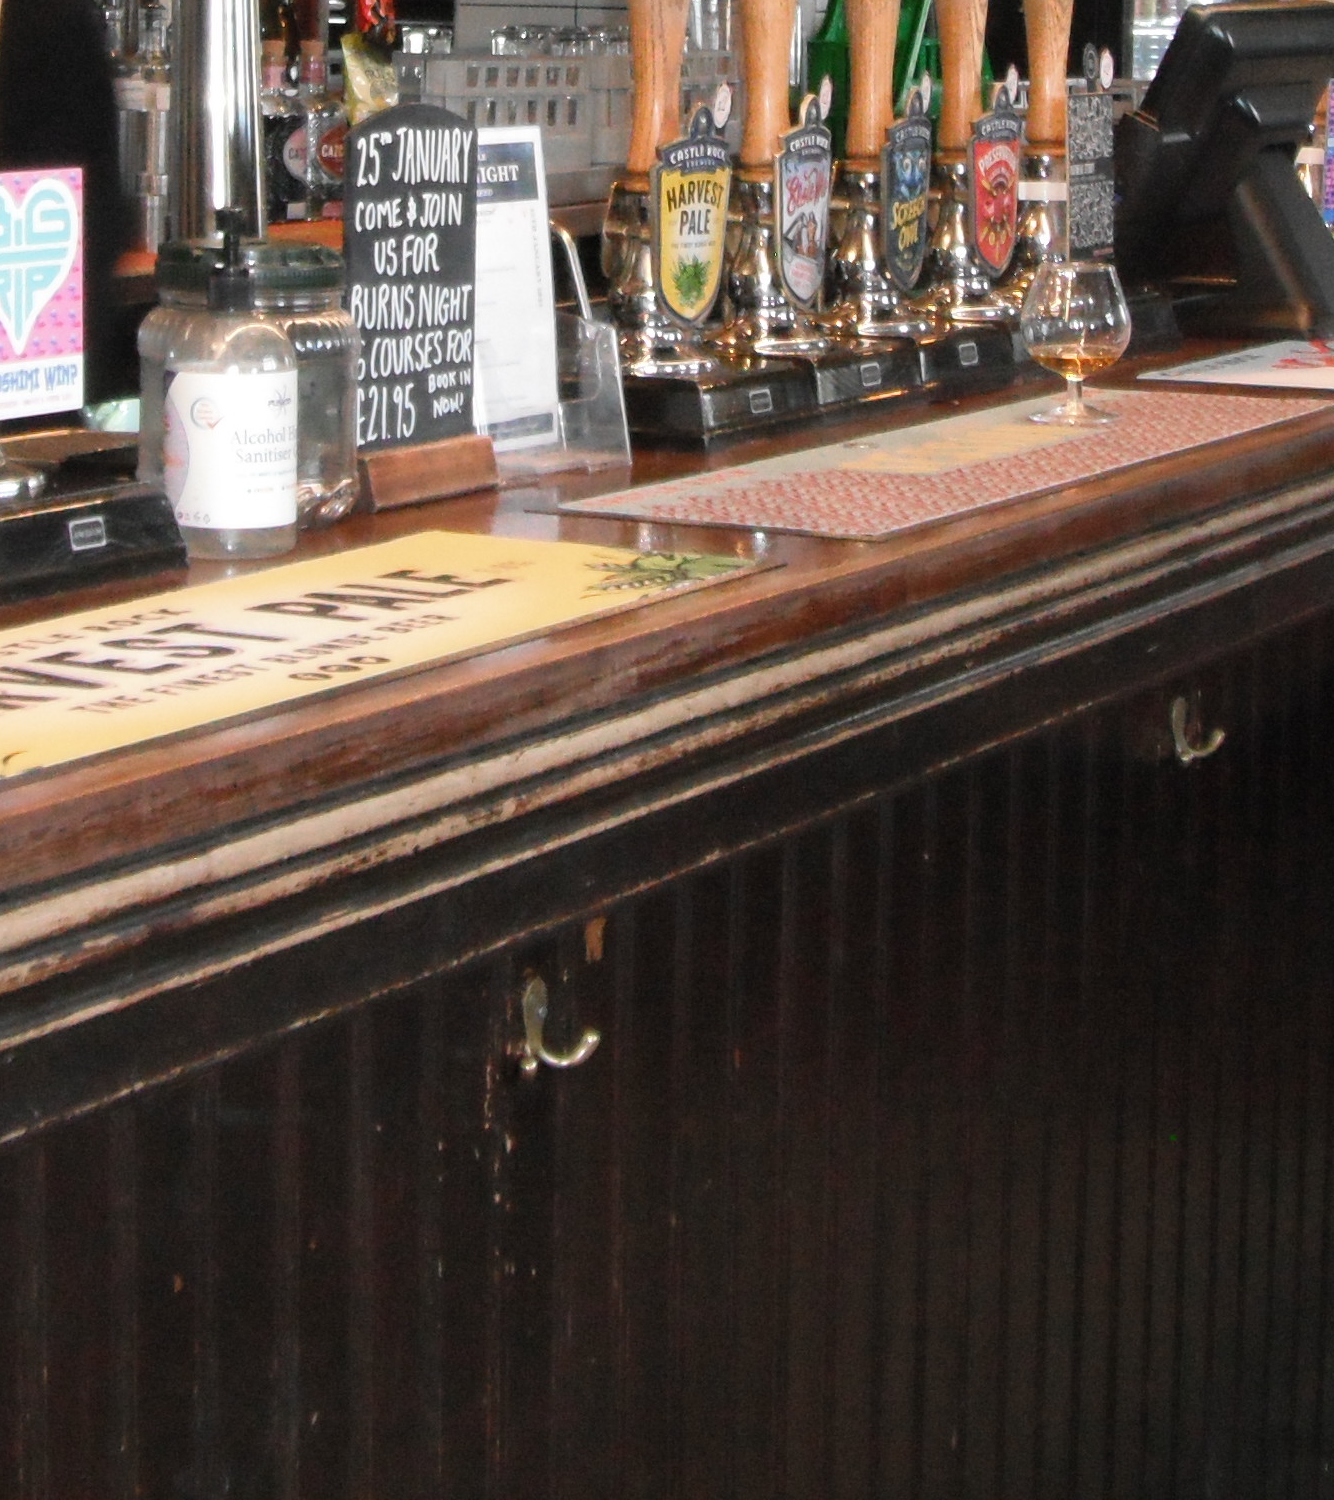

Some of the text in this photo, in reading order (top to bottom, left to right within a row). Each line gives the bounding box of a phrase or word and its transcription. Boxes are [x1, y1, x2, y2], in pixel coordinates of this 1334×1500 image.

[392, 127, 473, 185] JANUARY
[669, 147, 704, 166] CASTLE
[355, 192, 463, 233] COME JOIN
[666, 179, 727, 213] HARVEST
[679, 208, 712, 237] PALE
[374, 232, 441, 277] US FOR
[350, 283, 473, 331] BURNS NIGHT
[370, 328, 473, 381] COURSES FOR
[427, 370, 458, 394] BOOK
[459, 368, 472, 387] IN
[244, 567, 515, 623] PALE
[85, 606, 193, 635] ROCK
